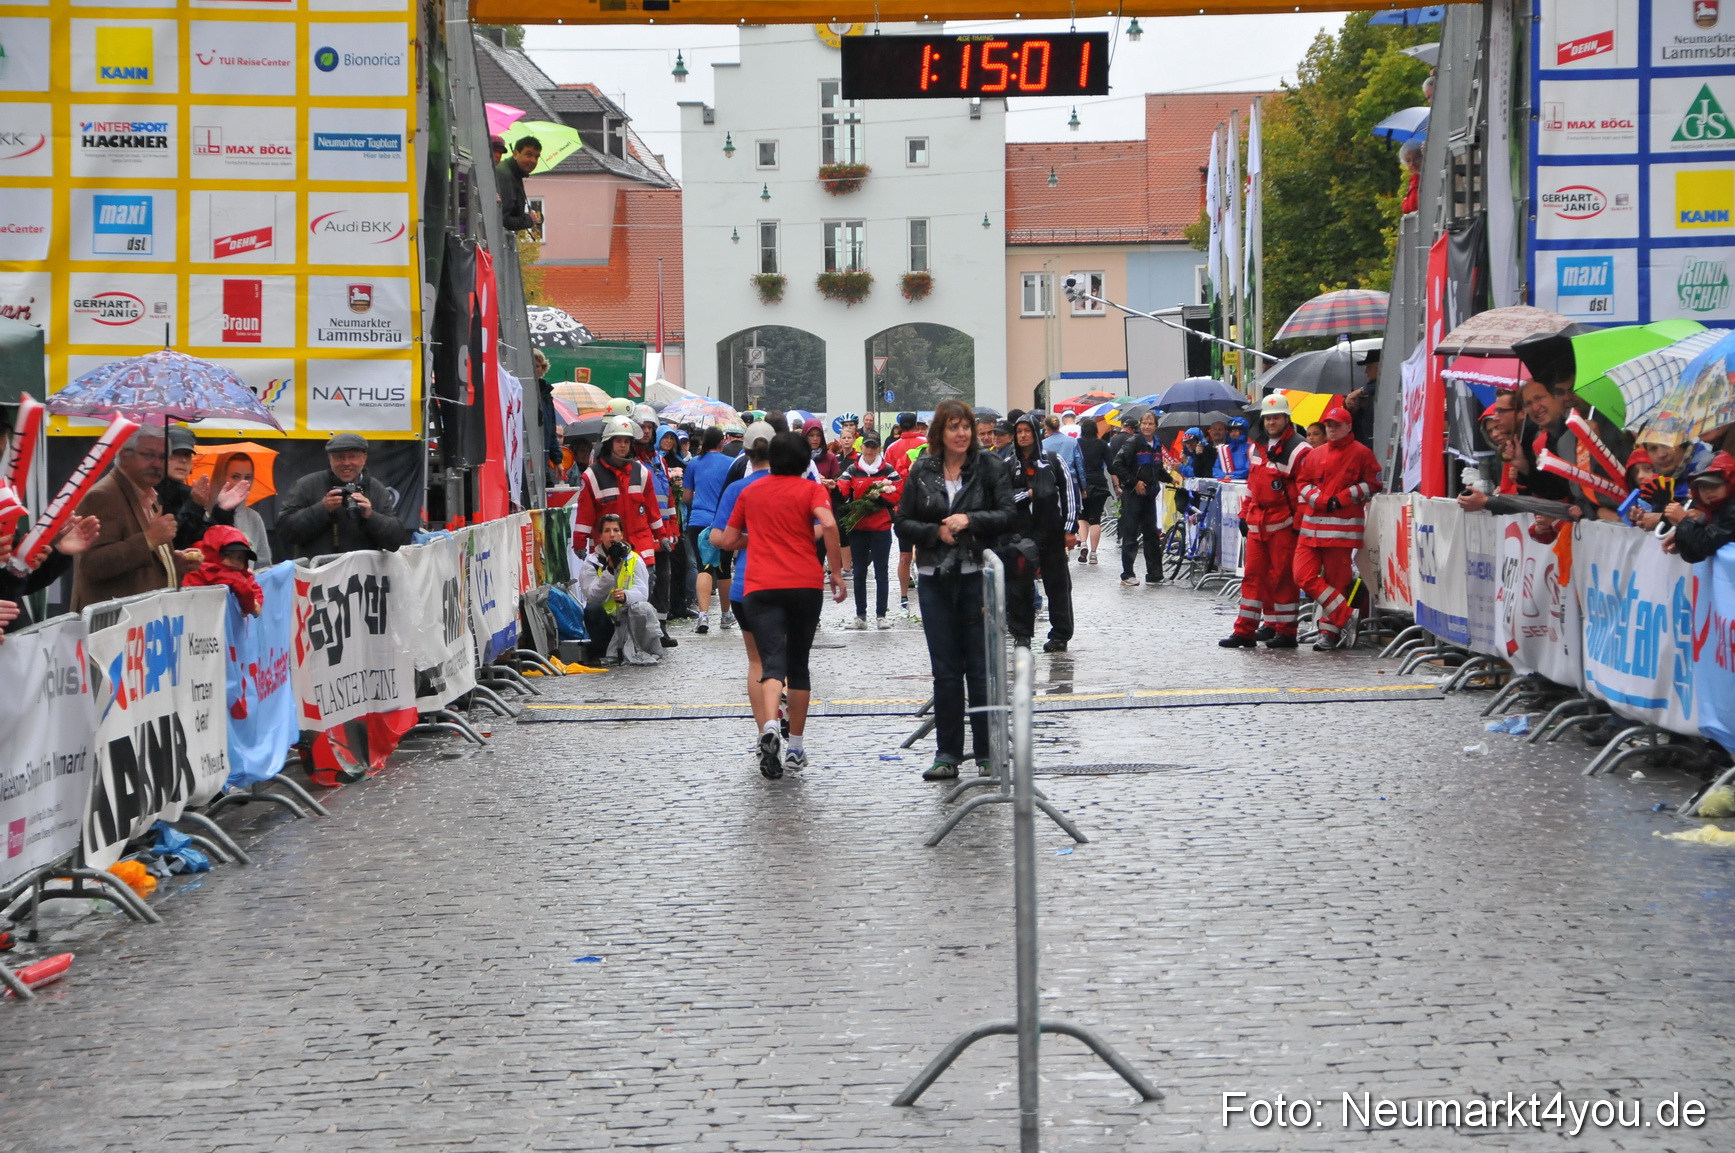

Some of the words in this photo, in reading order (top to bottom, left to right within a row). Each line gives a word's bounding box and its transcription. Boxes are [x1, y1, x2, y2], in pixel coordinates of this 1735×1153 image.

[1570, 39, 1599, 56] DEHN
[219, 57, 235, 65] TUI
[237, 57, 291, 67] ReiseCenter
[344, 52, 401, 66] Bionorica
[101, 66, 148, 79] KANN
[94, 121, 168, 133] INTERSPORT
[1567, 120, 1596, 129] MAX
[1601, 118, 1635, 129] BÖGL
[82, 134, 168, 149] HACKNER
[318, 137, 366, 148] Neumarkter
[367, 138, 398, 150] Tagblatt
[226, 145, 255, 154] MAX
[260, 143, 292, 155] BÖGL
[1542, 194, 1593, 203] GERHART
[99, 201, 147, 225] maxi
[1563, 203, 1600, 212] JANIG
[1680, 209, 1730, 223] KANN
[127, 237, 146, 251] dsl
[229, 235, 257, 251] DEHN
[1562, 262, 1608, 287] maxi
[1680, 256, 1727, 285] RUND
[73, 299, 131, 309] GERHART
[1590, 298, 1608, 312] dsl
[100, 310, 139, 318] JANIG
[222, 313, 259, 331] Braun
[329, 318, 391, 328] Neumarkter
[317, 328, 402, 342] Lammsbräu
[312, 386, 405, 407] NATHUS
